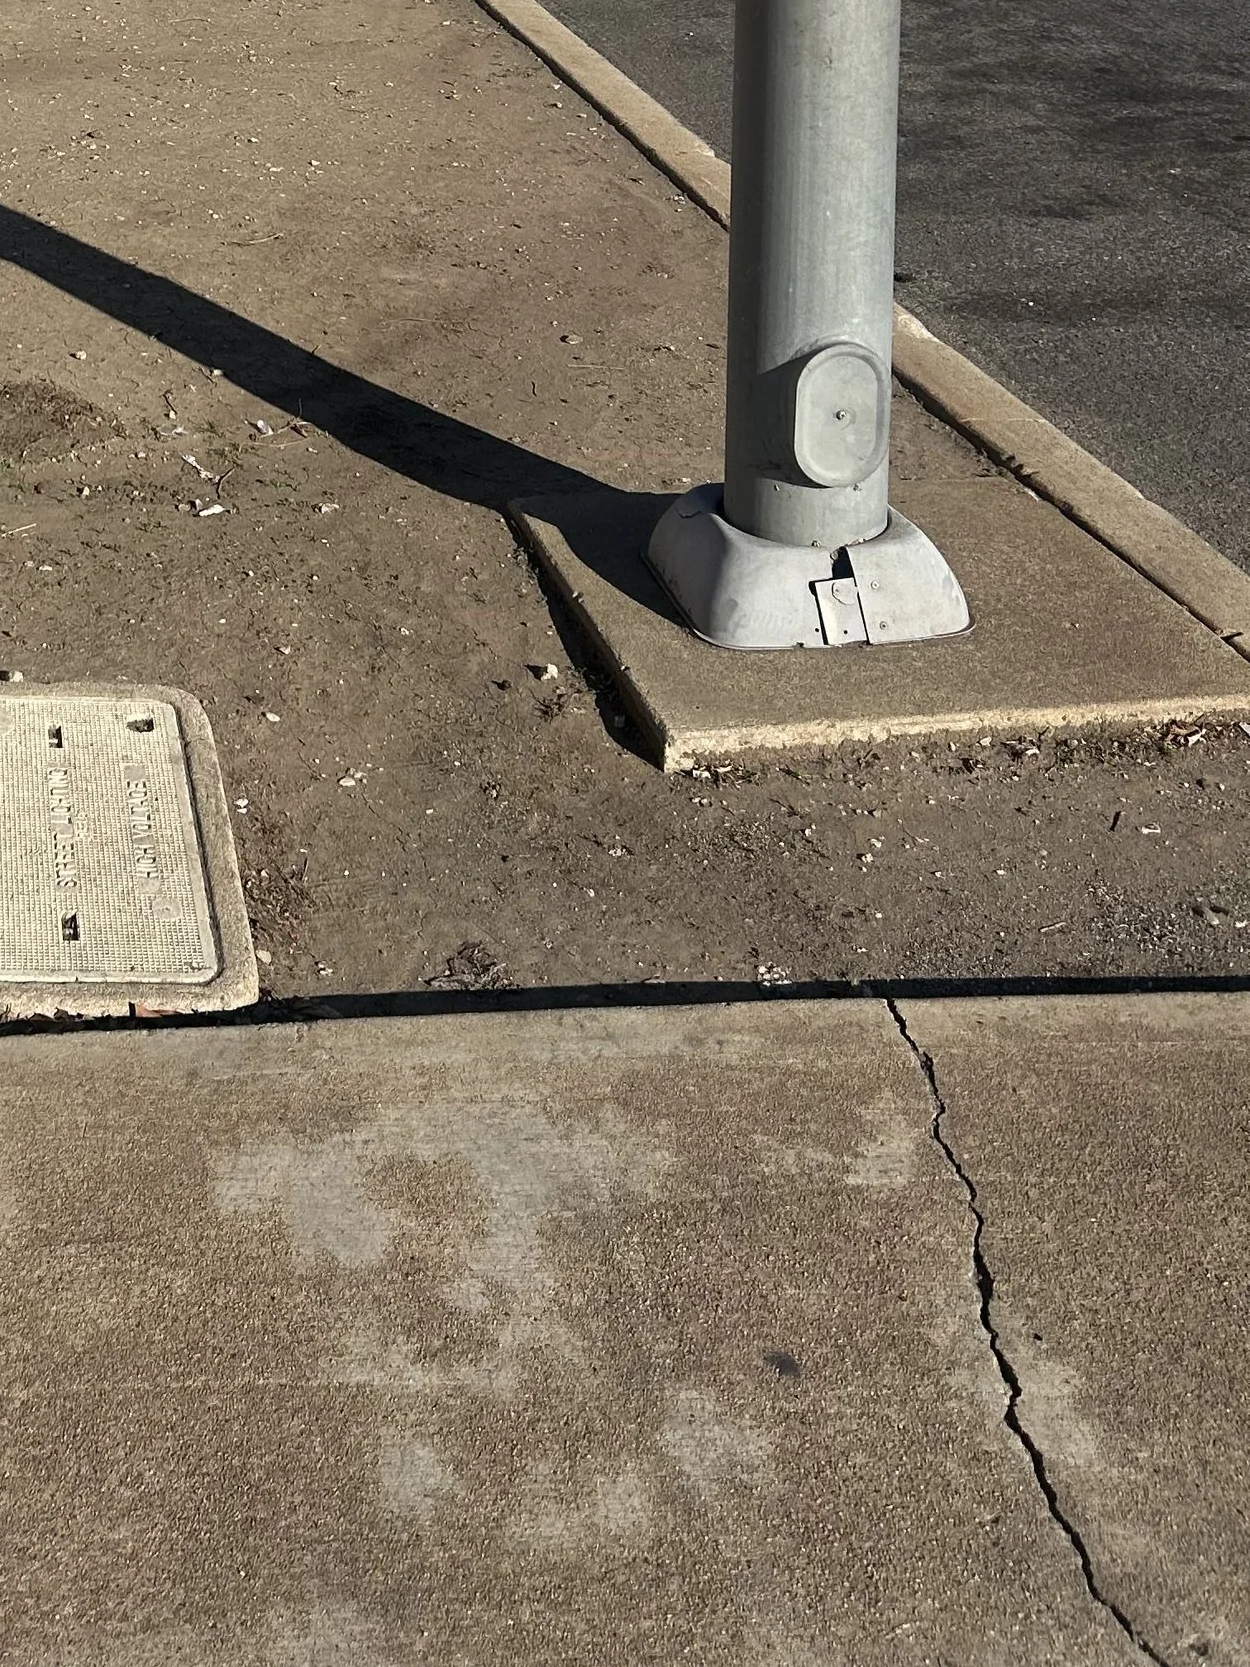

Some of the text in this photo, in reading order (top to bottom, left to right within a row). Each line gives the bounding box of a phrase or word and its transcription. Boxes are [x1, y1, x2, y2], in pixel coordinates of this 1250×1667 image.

[49, 767, 79, 888] STREET LIGHTING
[126, 780, 159, 879] HIGH VOLTAGE
